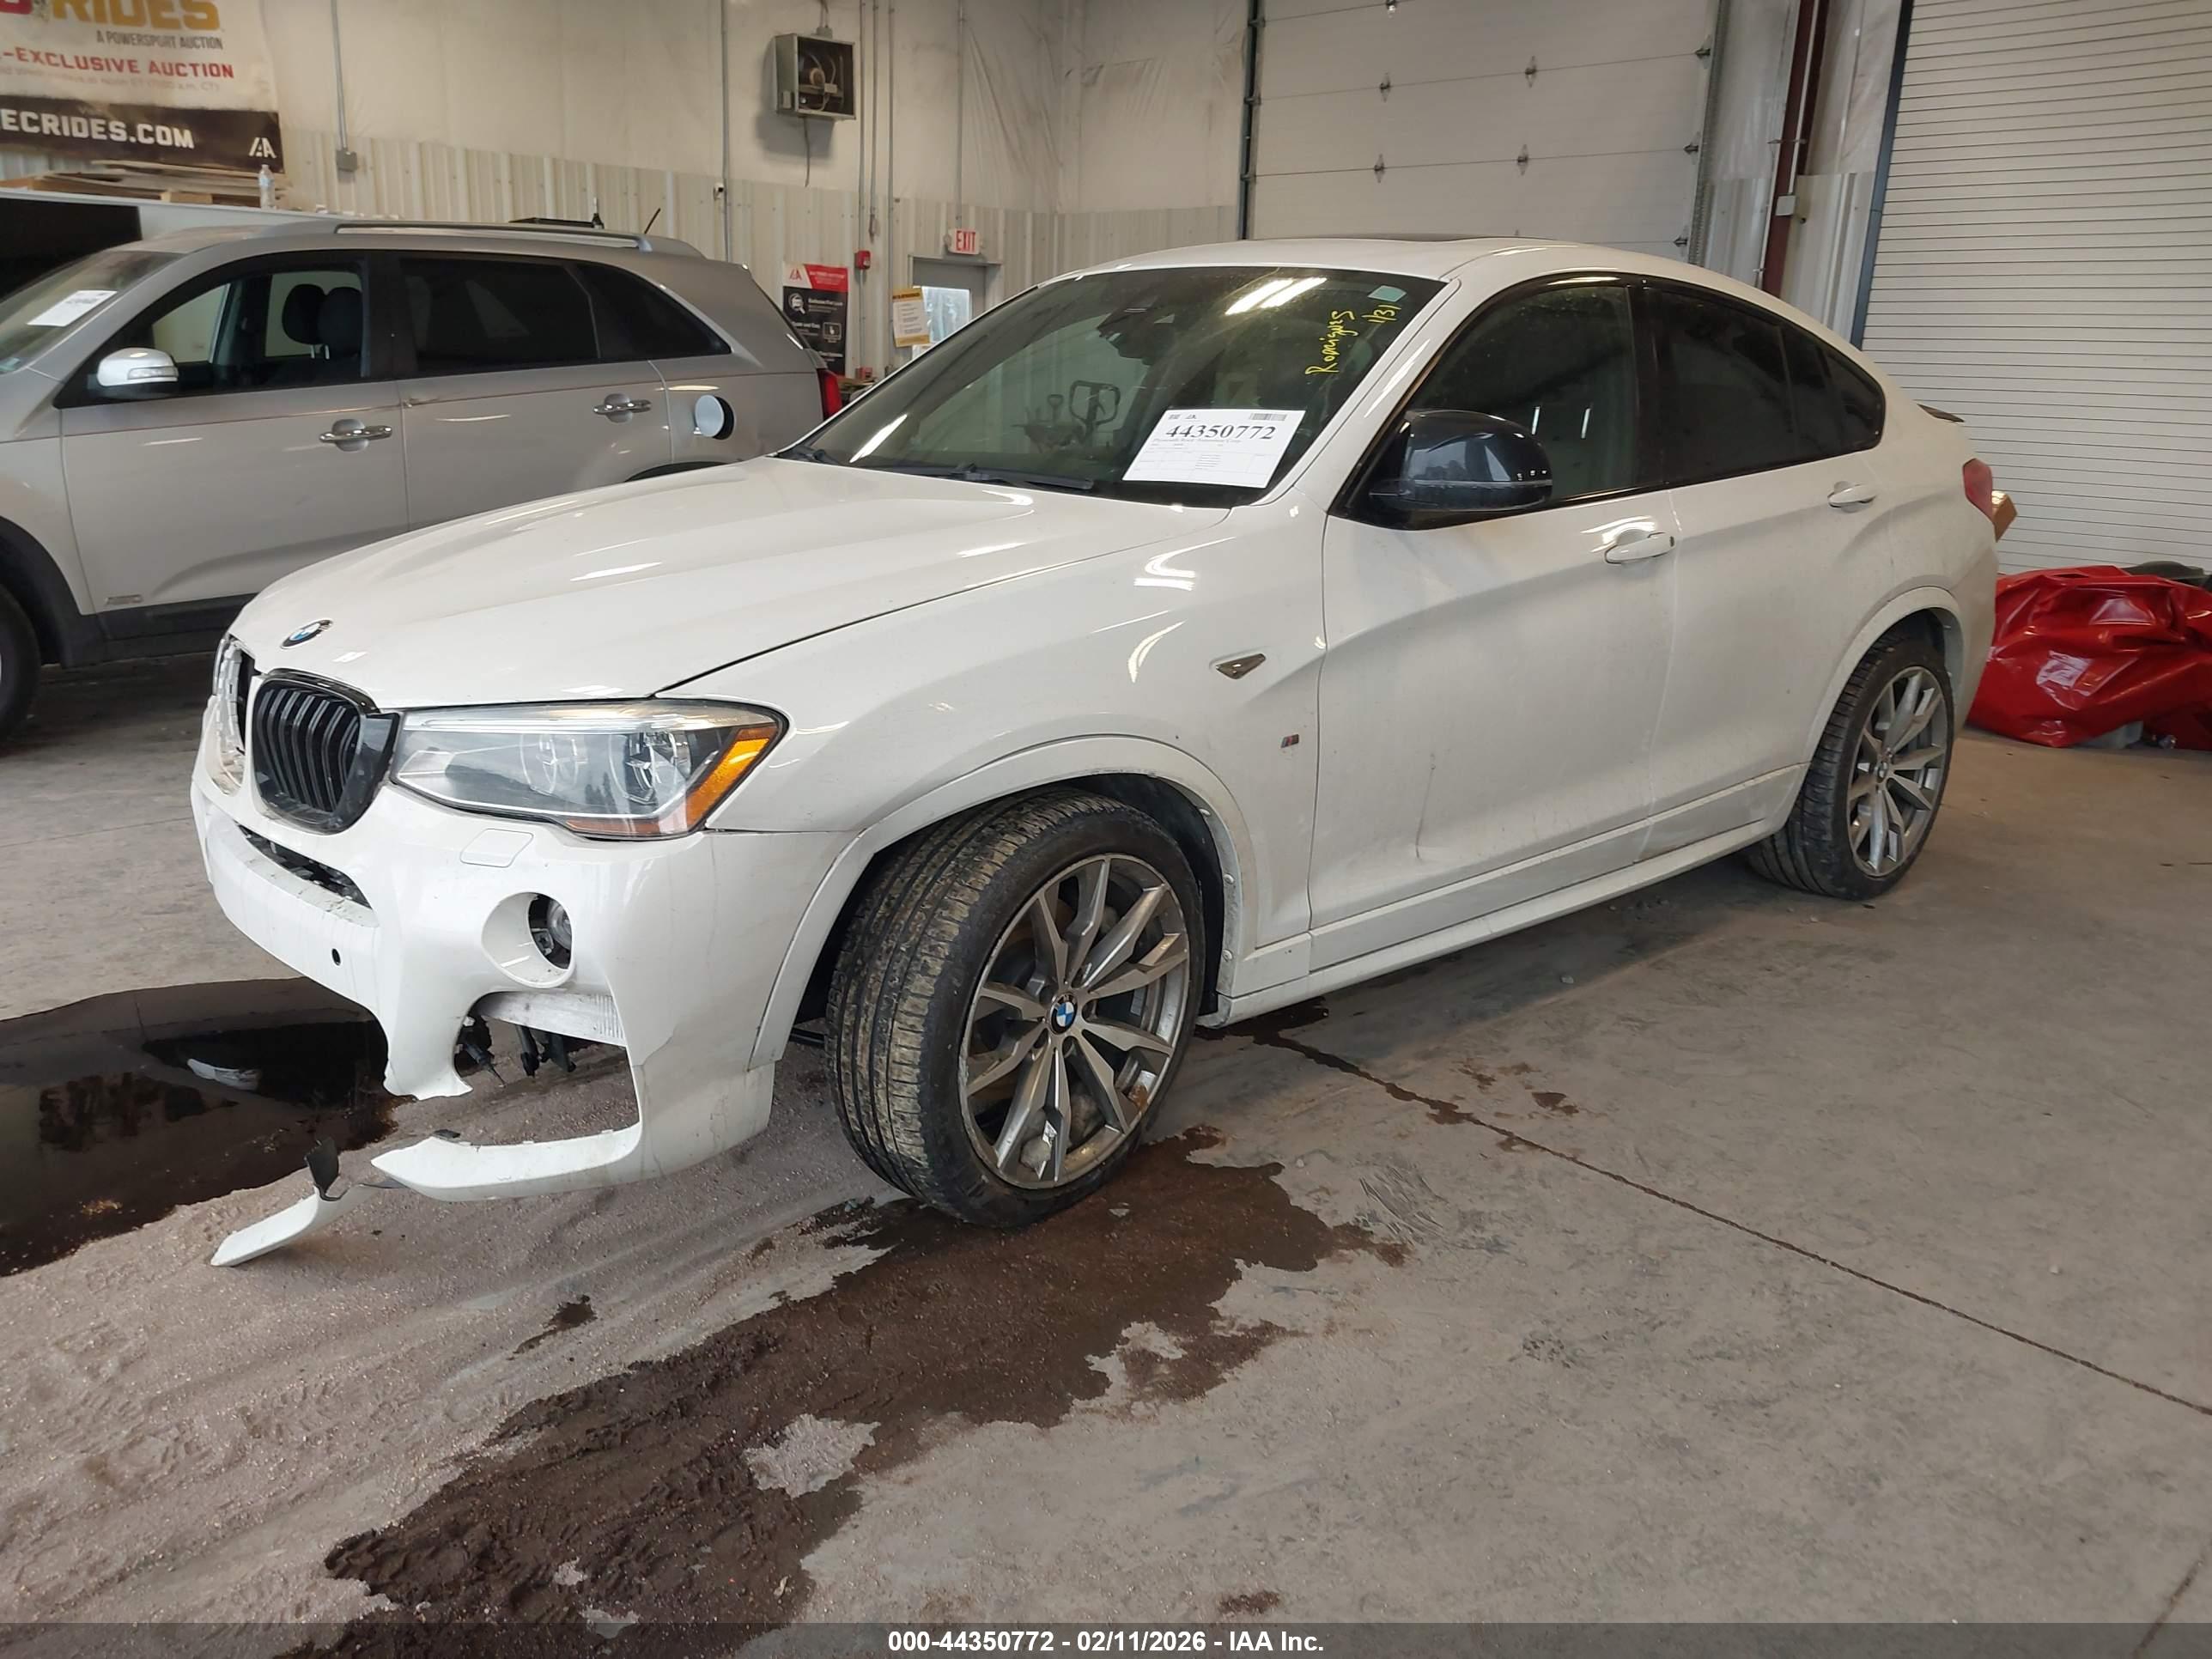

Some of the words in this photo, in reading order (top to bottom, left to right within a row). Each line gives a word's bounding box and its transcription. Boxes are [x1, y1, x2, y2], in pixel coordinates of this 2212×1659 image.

[96, 30, 104, 43] A
[106, 31, 176, 48] POWERSPORT
[179, 37, 223, 50] AUCTION
[149, 60, 234, 79] AUCTION
[0, 108, 194, 149] ECRIDES.COM
[956, 230, 976, 252] EXIT
[1165, 424, 1277, 440] 44350772
